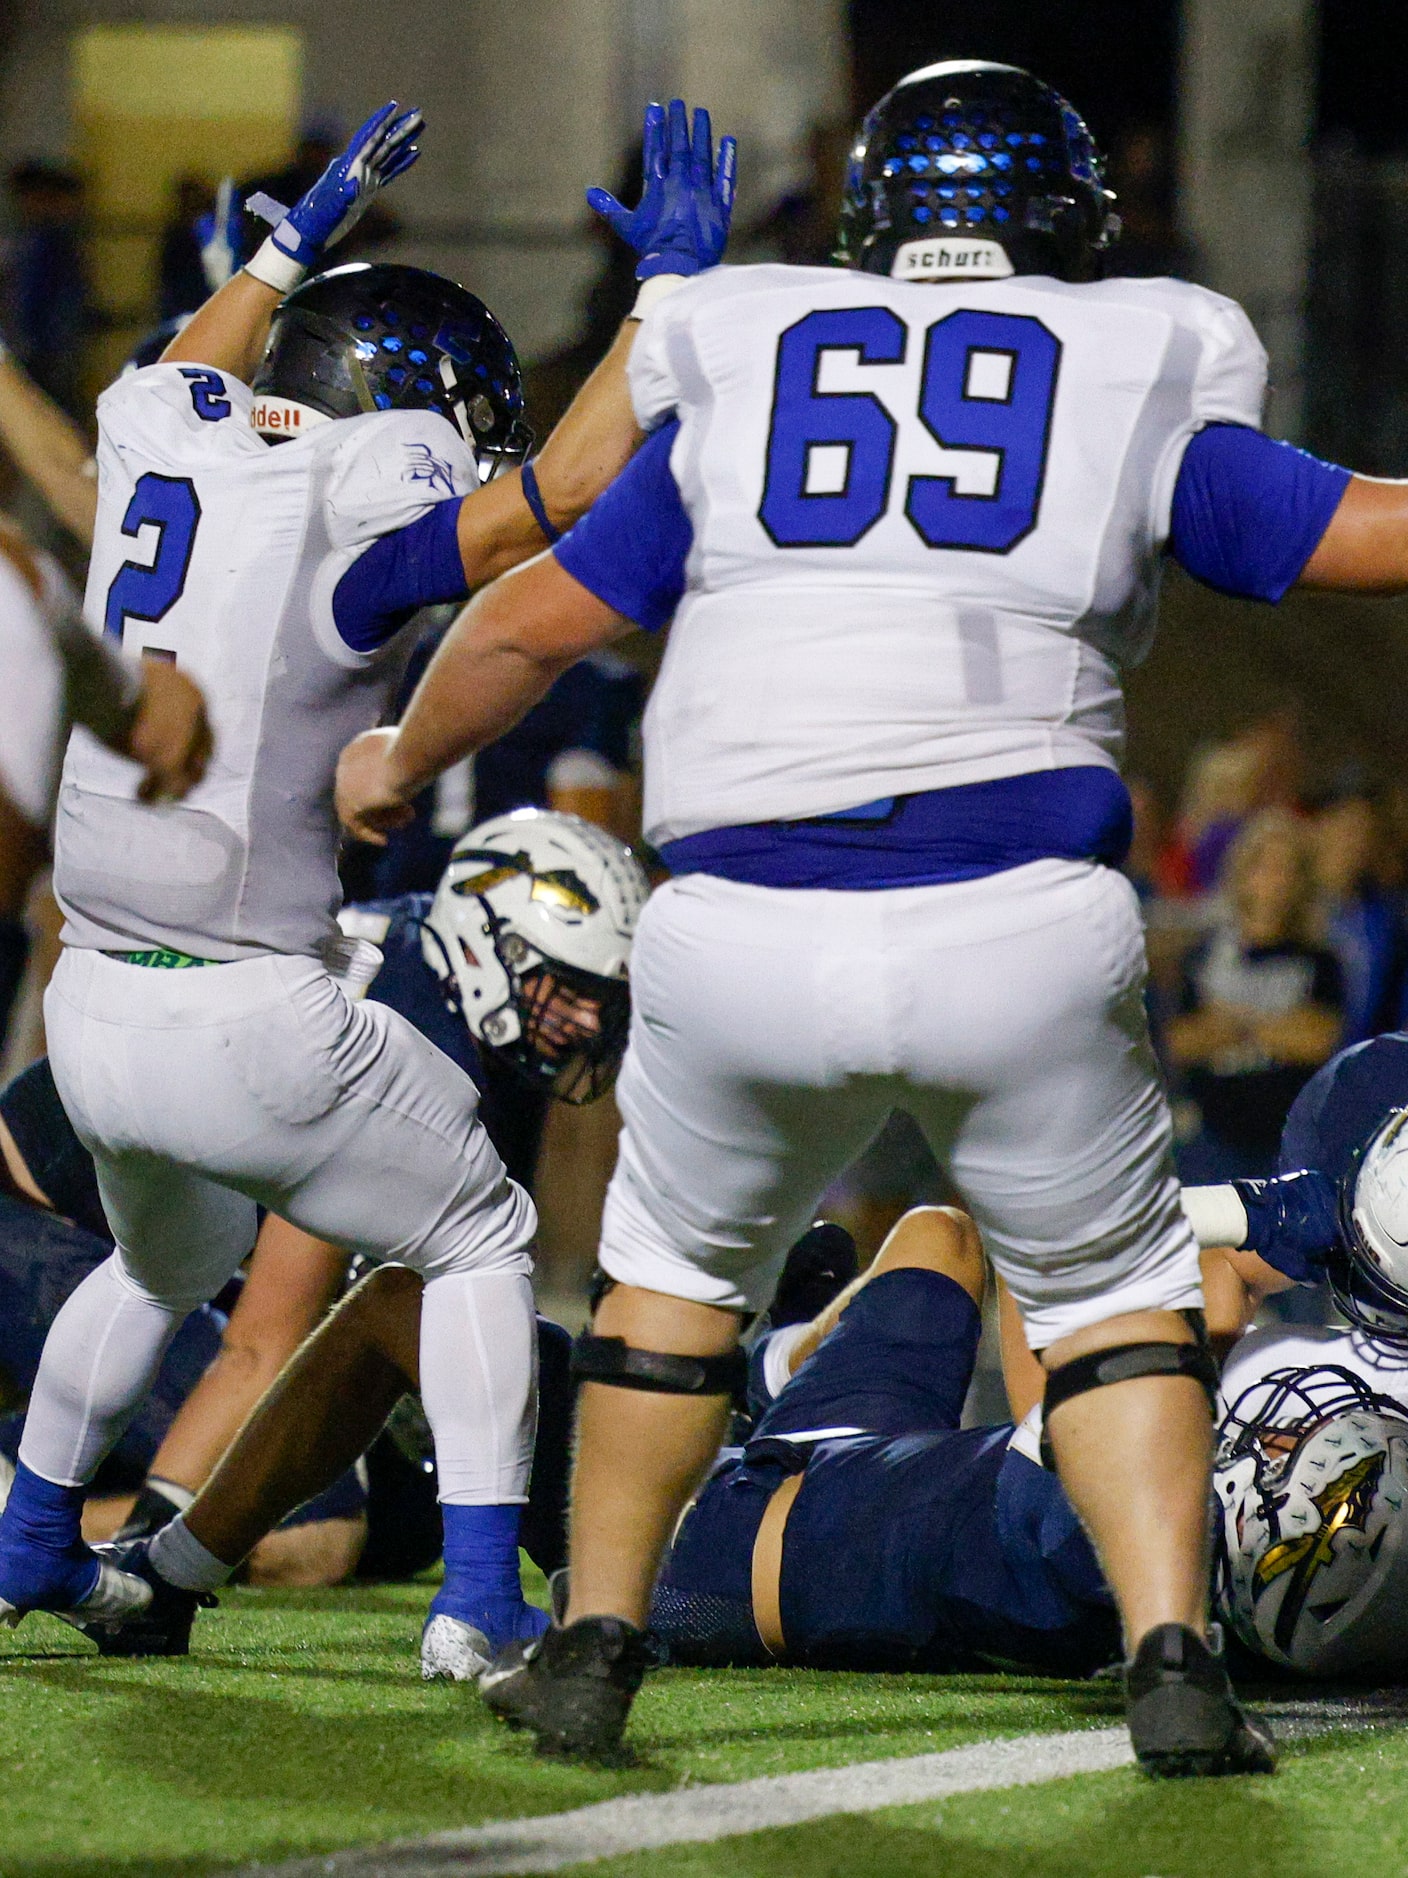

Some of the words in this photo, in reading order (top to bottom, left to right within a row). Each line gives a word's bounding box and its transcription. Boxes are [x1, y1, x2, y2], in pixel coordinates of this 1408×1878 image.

[178, 368, 232, 422] 2
[250, 404, 300, 430] ddell
[756, 305, 1064, 556] 69
[102, 470, 203, 672] 2
